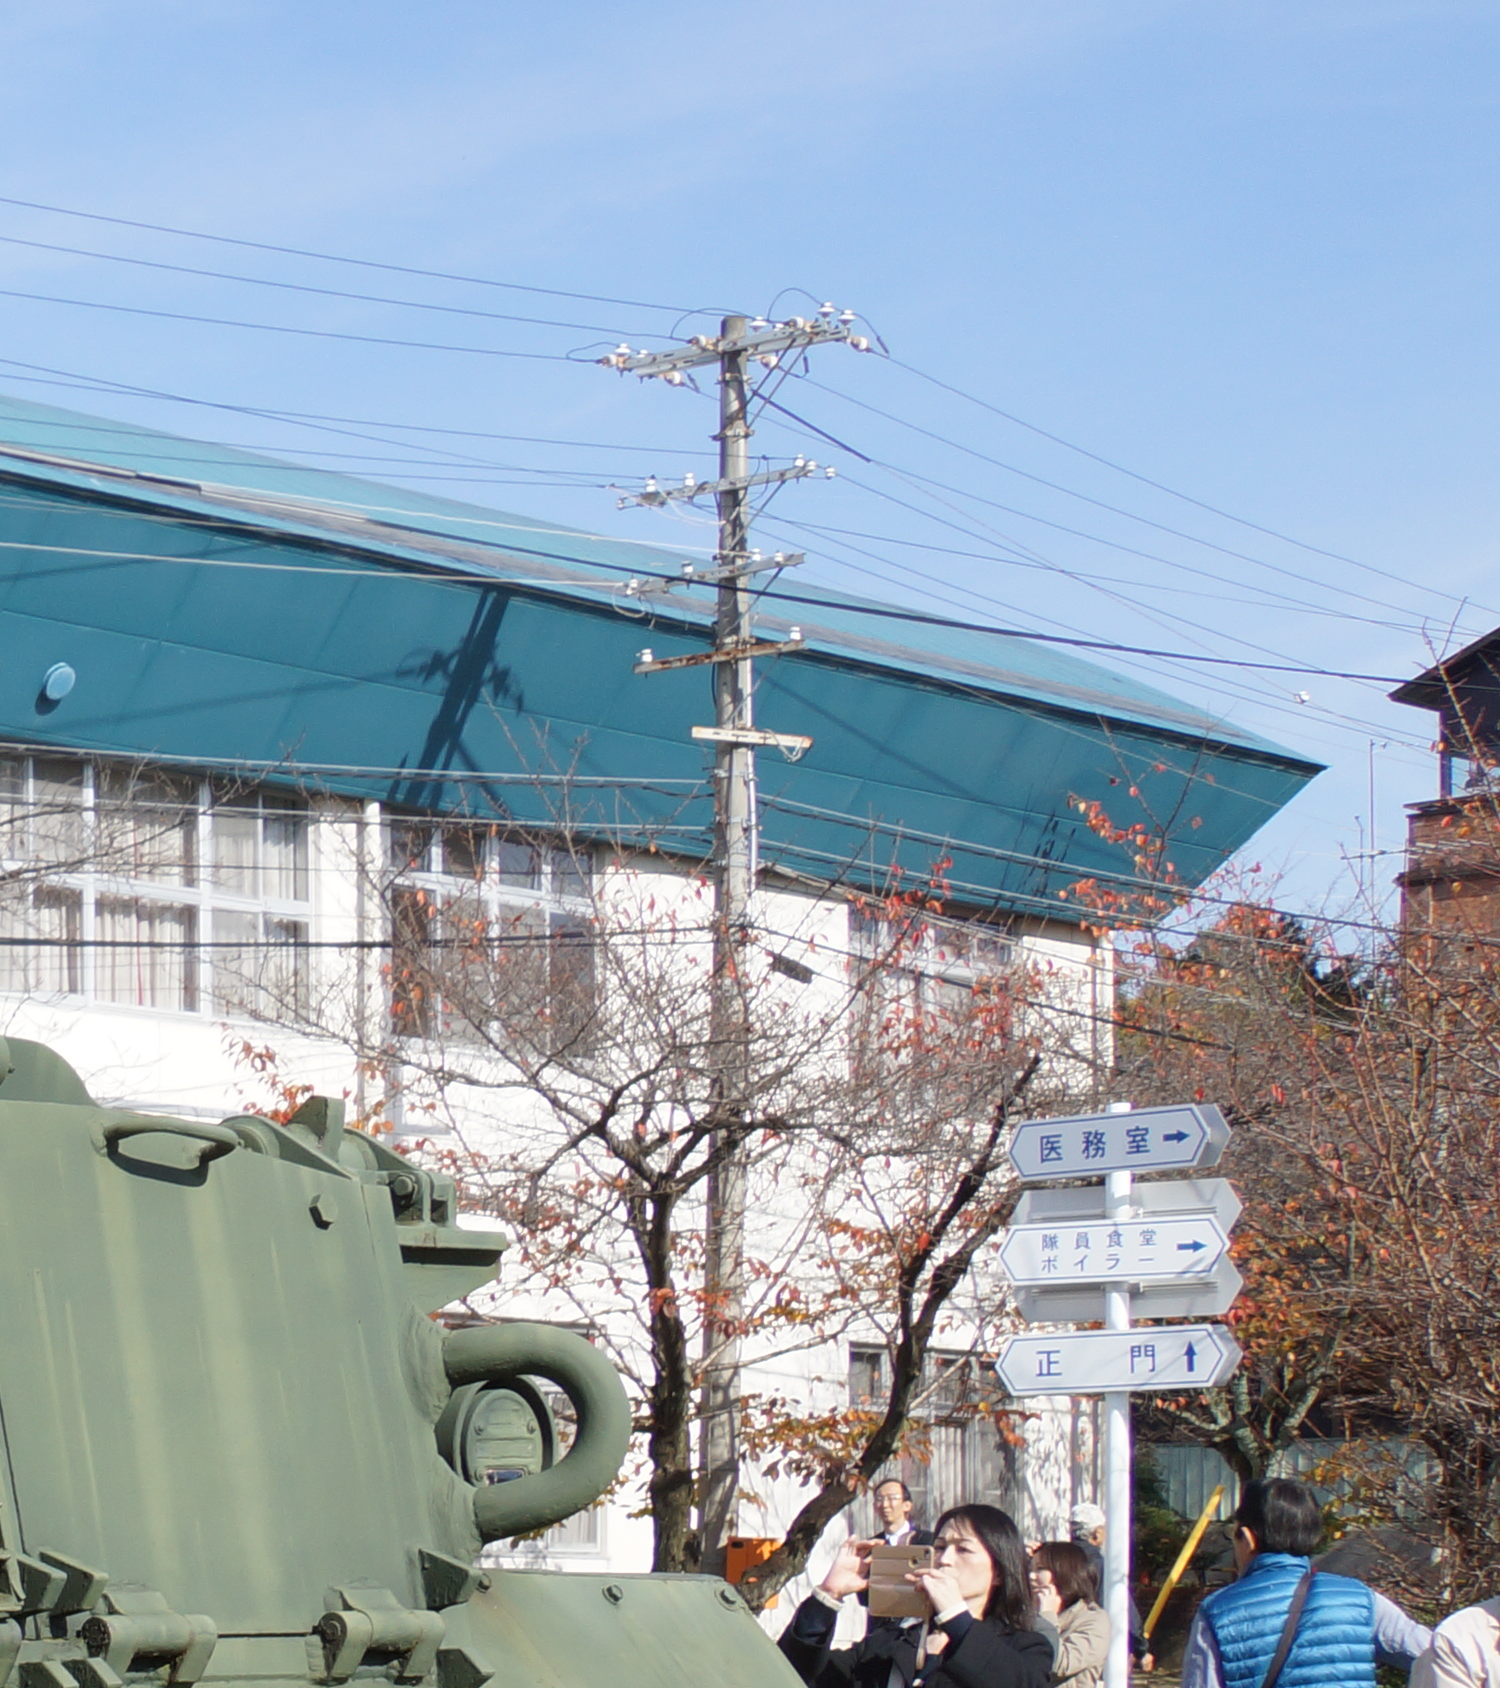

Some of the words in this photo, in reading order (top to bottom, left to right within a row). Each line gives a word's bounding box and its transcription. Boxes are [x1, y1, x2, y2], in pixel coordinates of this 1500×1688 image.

[1039, 1126, 1150, 1163] 医務室
[1042, 1228, 1157, 1251] 隊員食堂
[1041, 1254, 1154, 1273] ボイラー
[1035, 1344, 1155, 1377] 正門
